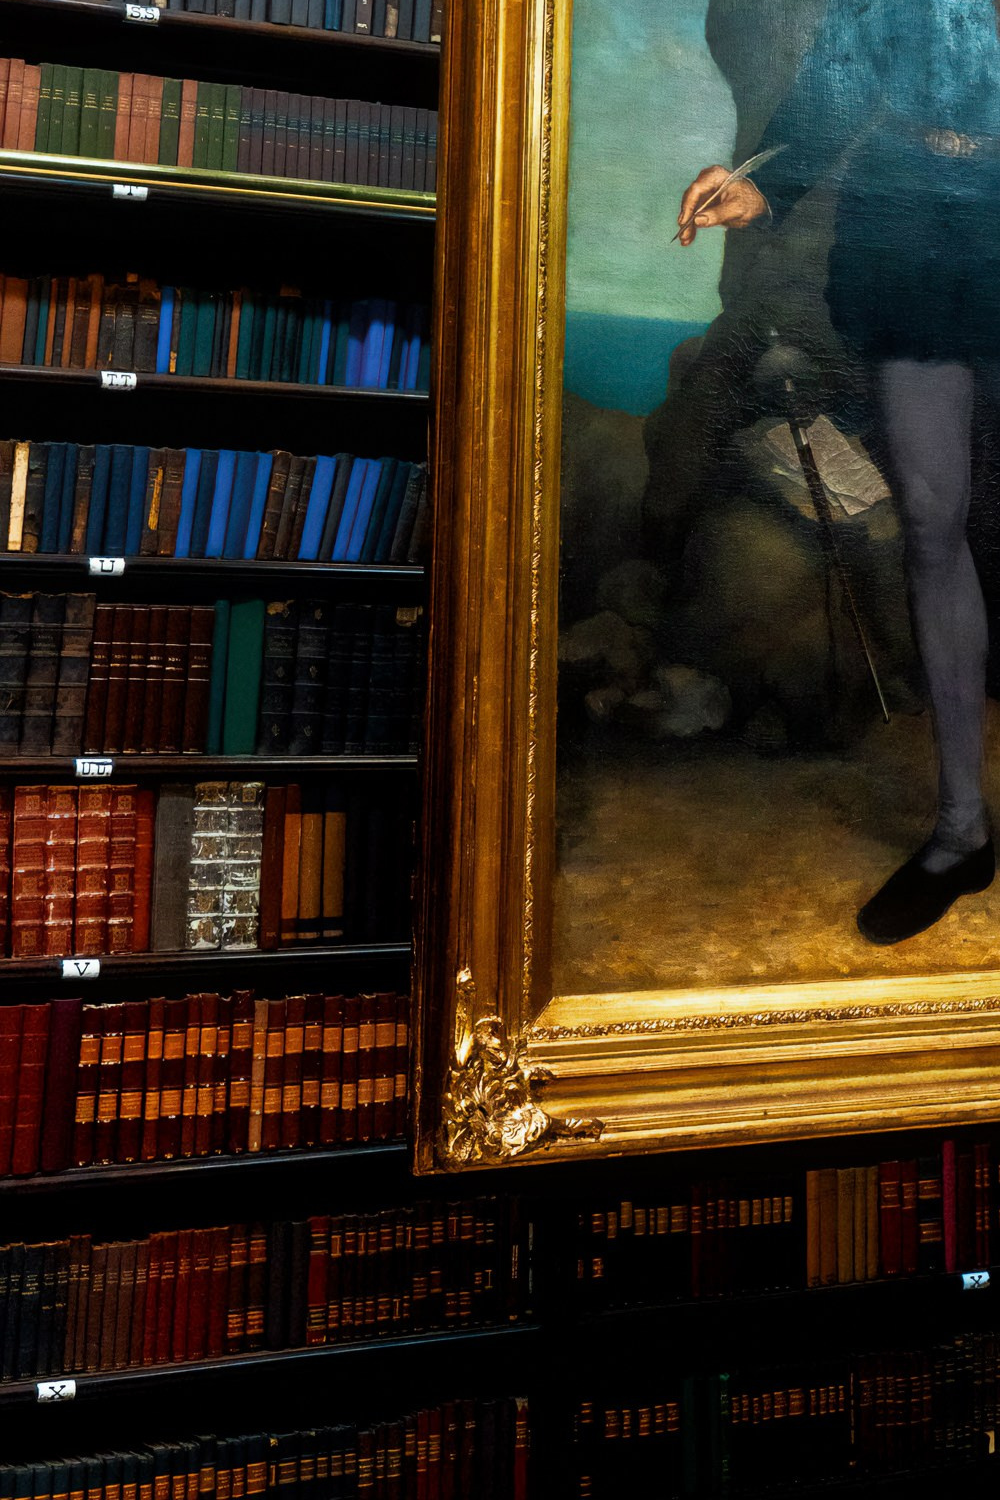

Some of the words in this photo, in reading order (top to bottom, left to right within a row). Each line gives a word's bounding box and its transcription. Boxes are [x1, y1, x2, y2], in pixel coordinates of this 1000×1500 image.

[131, 6, 157, 21] S.S.
[107, 373, 133, 387] T.T.
[99, 560, 115, 573] U
[74, 962, 90, 976] V
[970, 1275, 983, 1288] X
[49, 1385, 66, 1399] X
